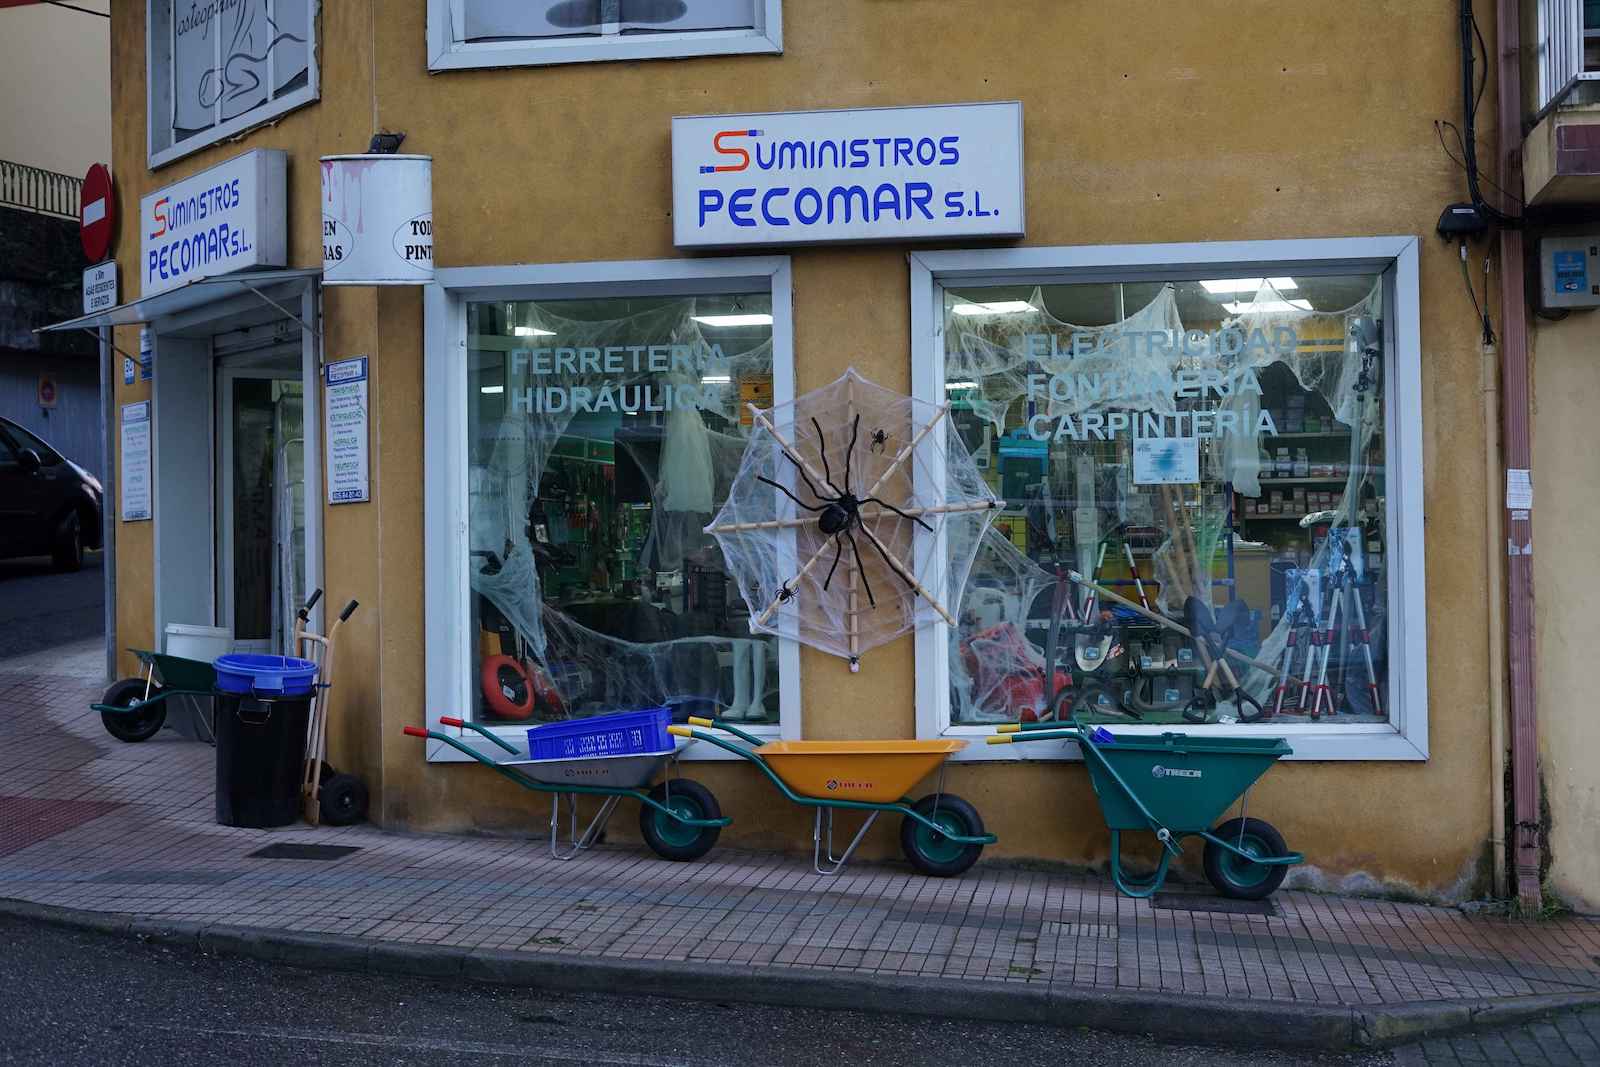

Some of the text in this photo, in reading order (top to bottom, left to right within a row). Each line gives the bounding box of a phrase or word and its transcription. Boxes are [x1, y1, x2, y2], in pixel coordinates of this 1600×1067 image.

[699, 128, 960, 174] SUMINISTROS
[149, 179, 239, 240] SUMINISTROS
[698, 181, 1000, 228] PECOMAR S.L.
[149, 223, 252, 284] PECOMAR S.L.
